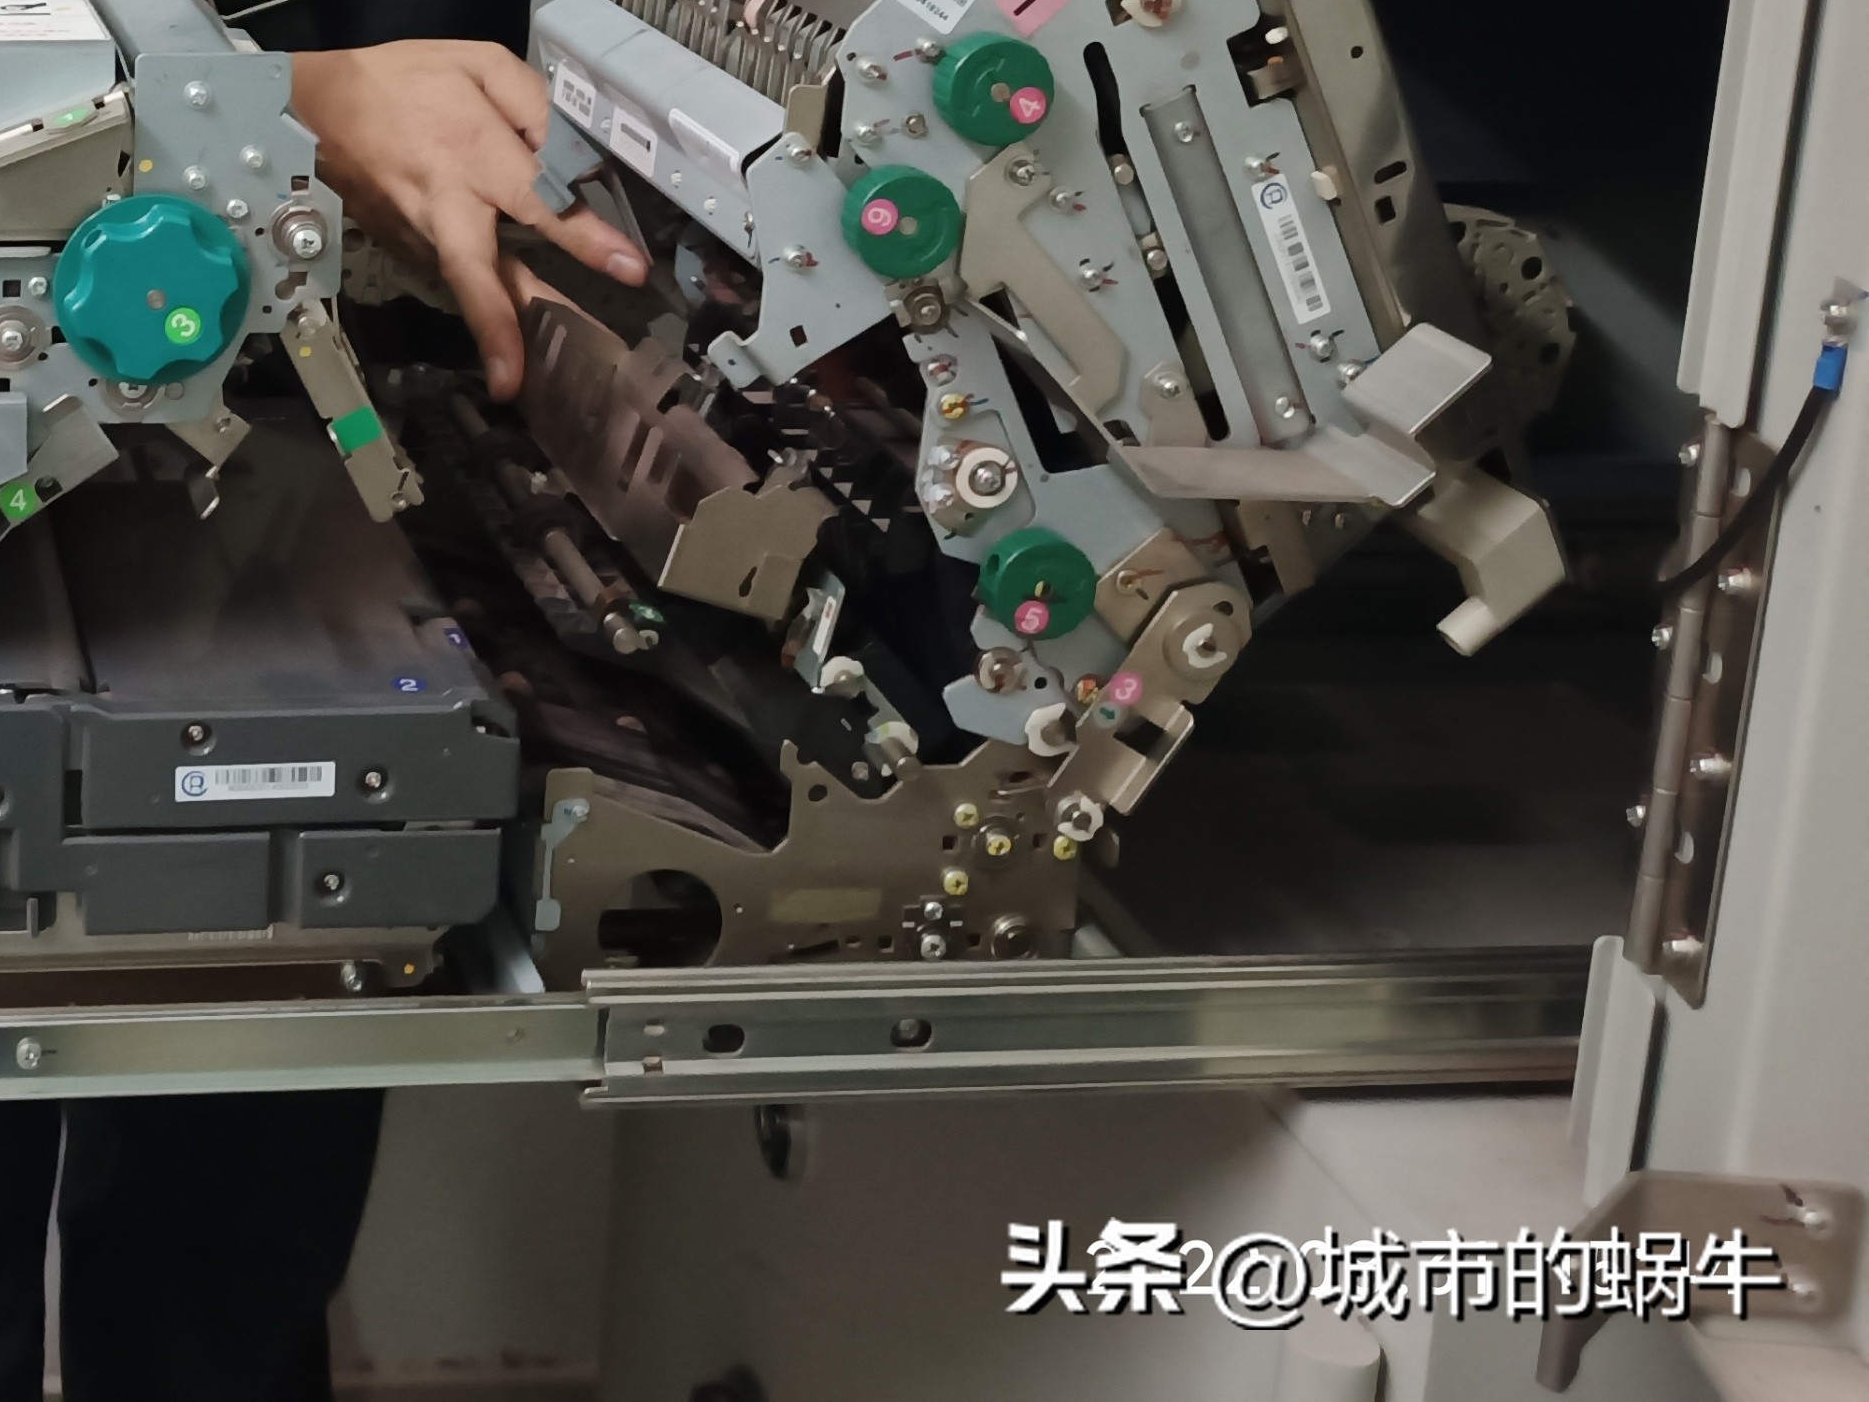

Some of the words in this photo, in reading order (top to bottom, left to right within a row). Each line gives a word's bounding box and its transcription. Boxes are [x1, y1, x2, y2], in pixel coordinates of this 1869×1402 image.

[171, 313, 196, 337] 3
[10, 488, 27, 511] 4
[1021, 607, 1042, 632] 5
[399, 678, 418, 692] 2
